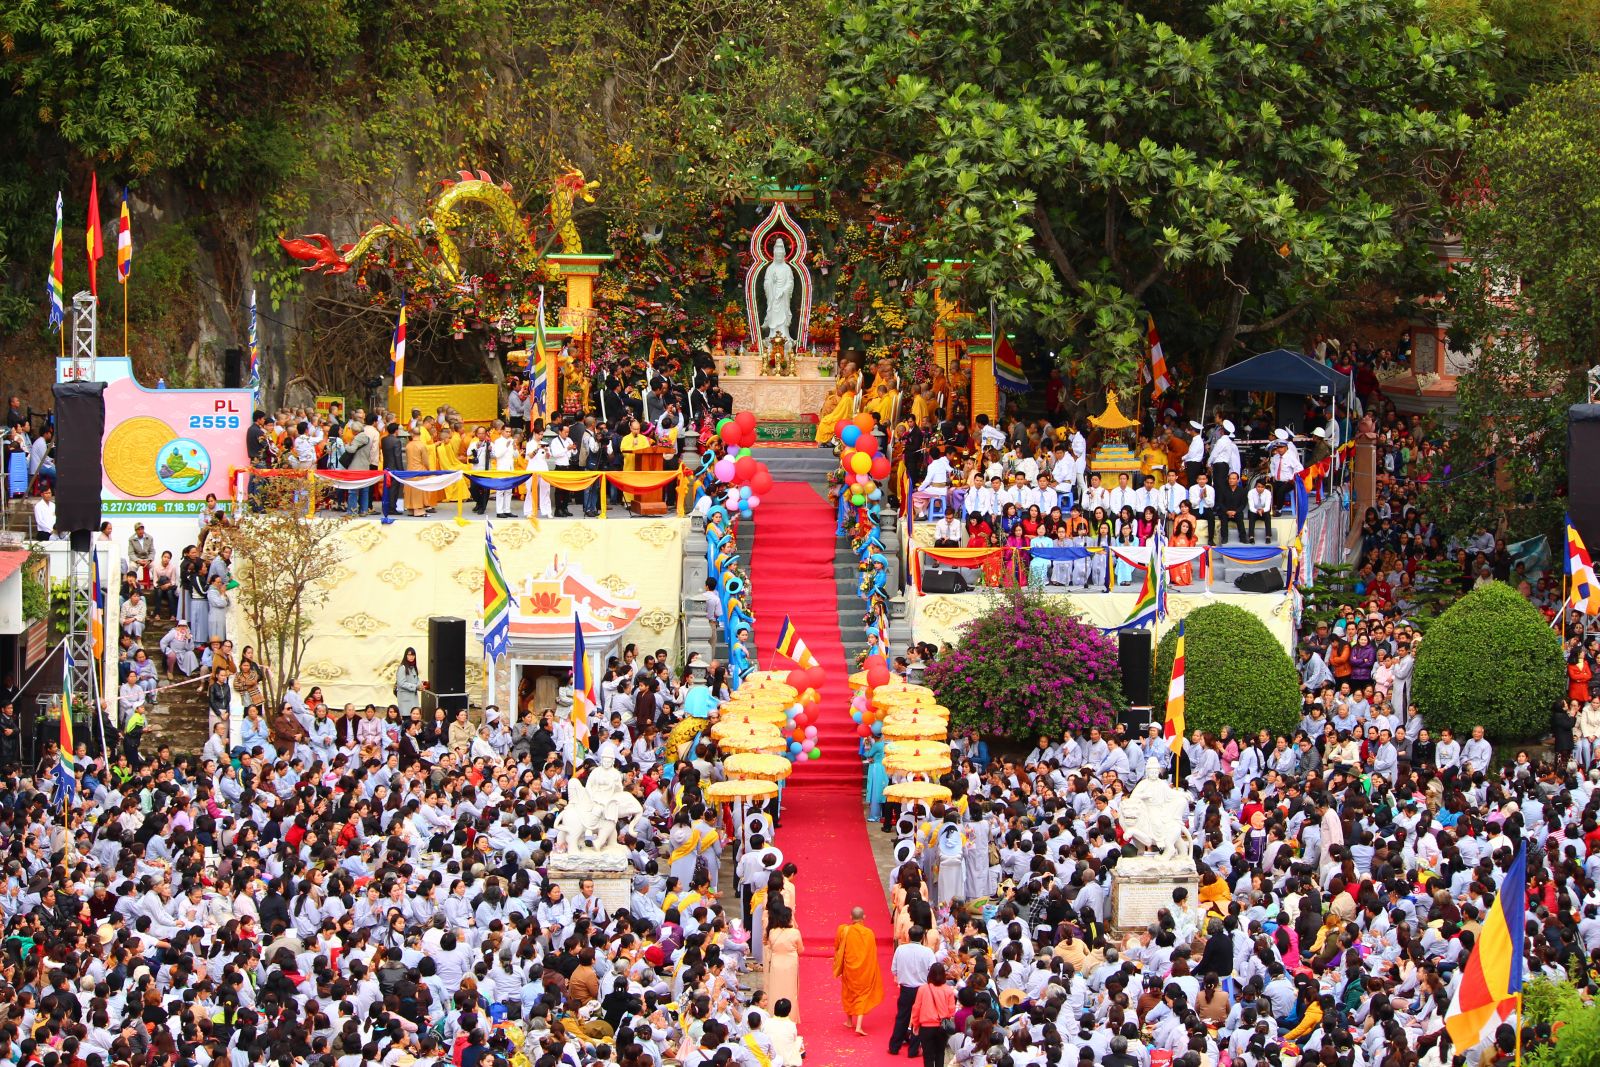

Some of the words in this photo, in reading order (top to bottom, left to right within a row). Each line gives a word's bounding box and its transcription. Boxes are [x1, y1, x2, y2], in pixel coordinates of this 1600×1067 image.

[214, 399, 239, 413] PL
[189, 415, 240, 429] 2559
[100, 502, 157, 512] 6.27/3/2016
